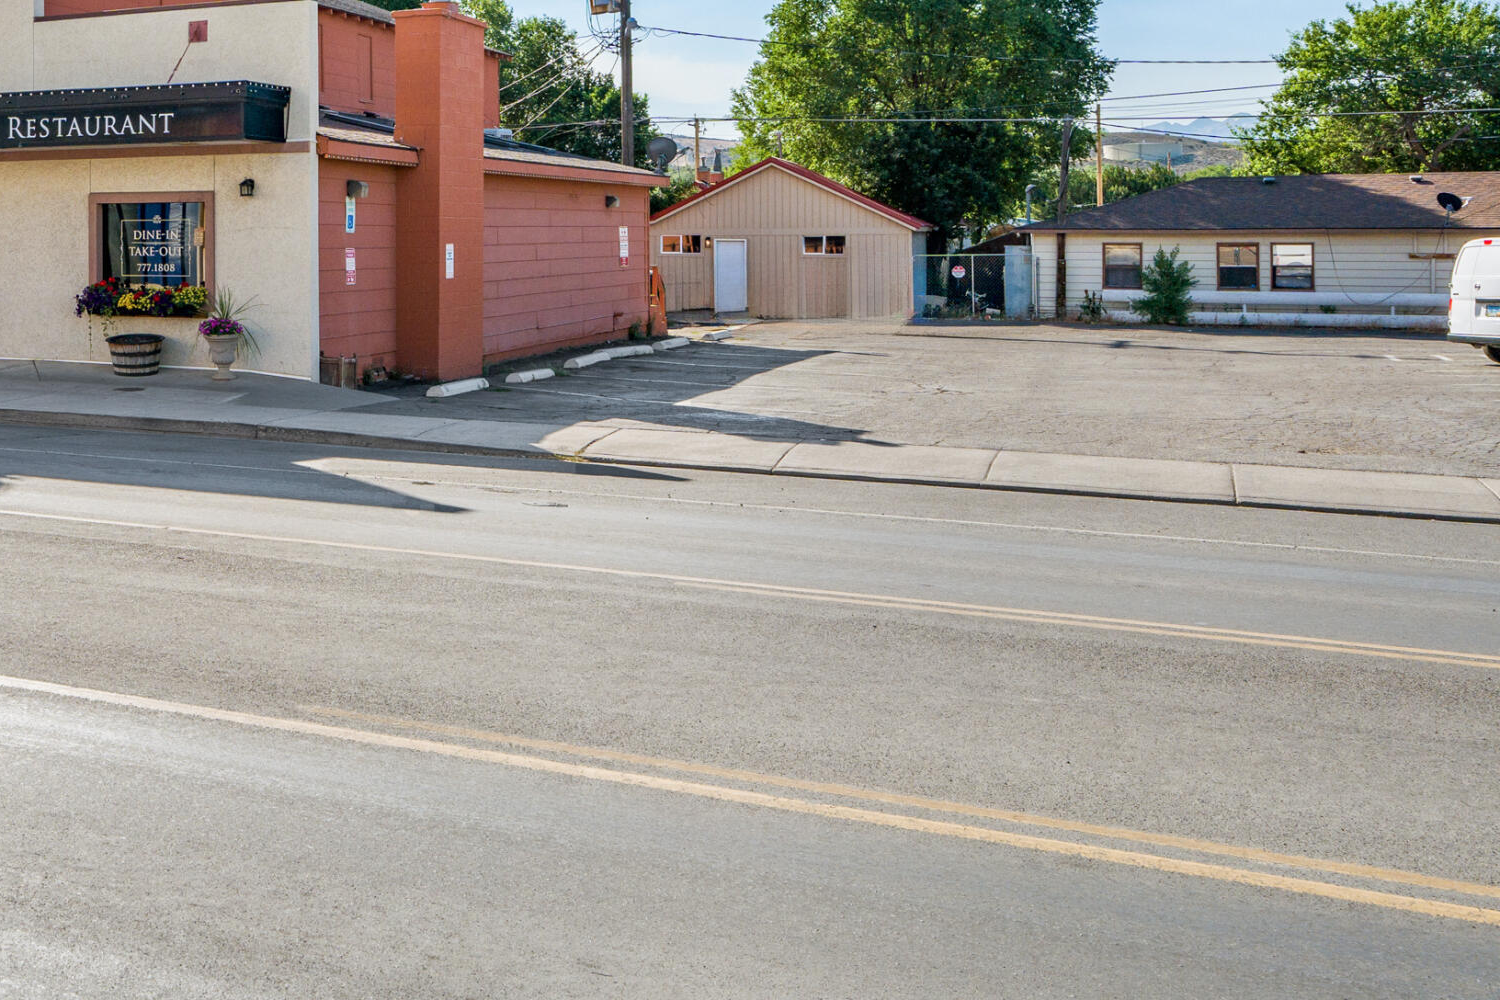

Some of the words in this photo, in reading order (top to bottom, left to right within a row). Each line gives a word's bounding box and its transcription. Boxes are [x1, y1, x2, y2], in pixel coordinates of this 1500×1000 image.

[7, 113, 175, 140] RESTAURANT
[133, 230, 179, 240] DINE-IN
[128, 246, 184, 257] TAKE-OUT
[136, 263, 176, 272] 777.1808
